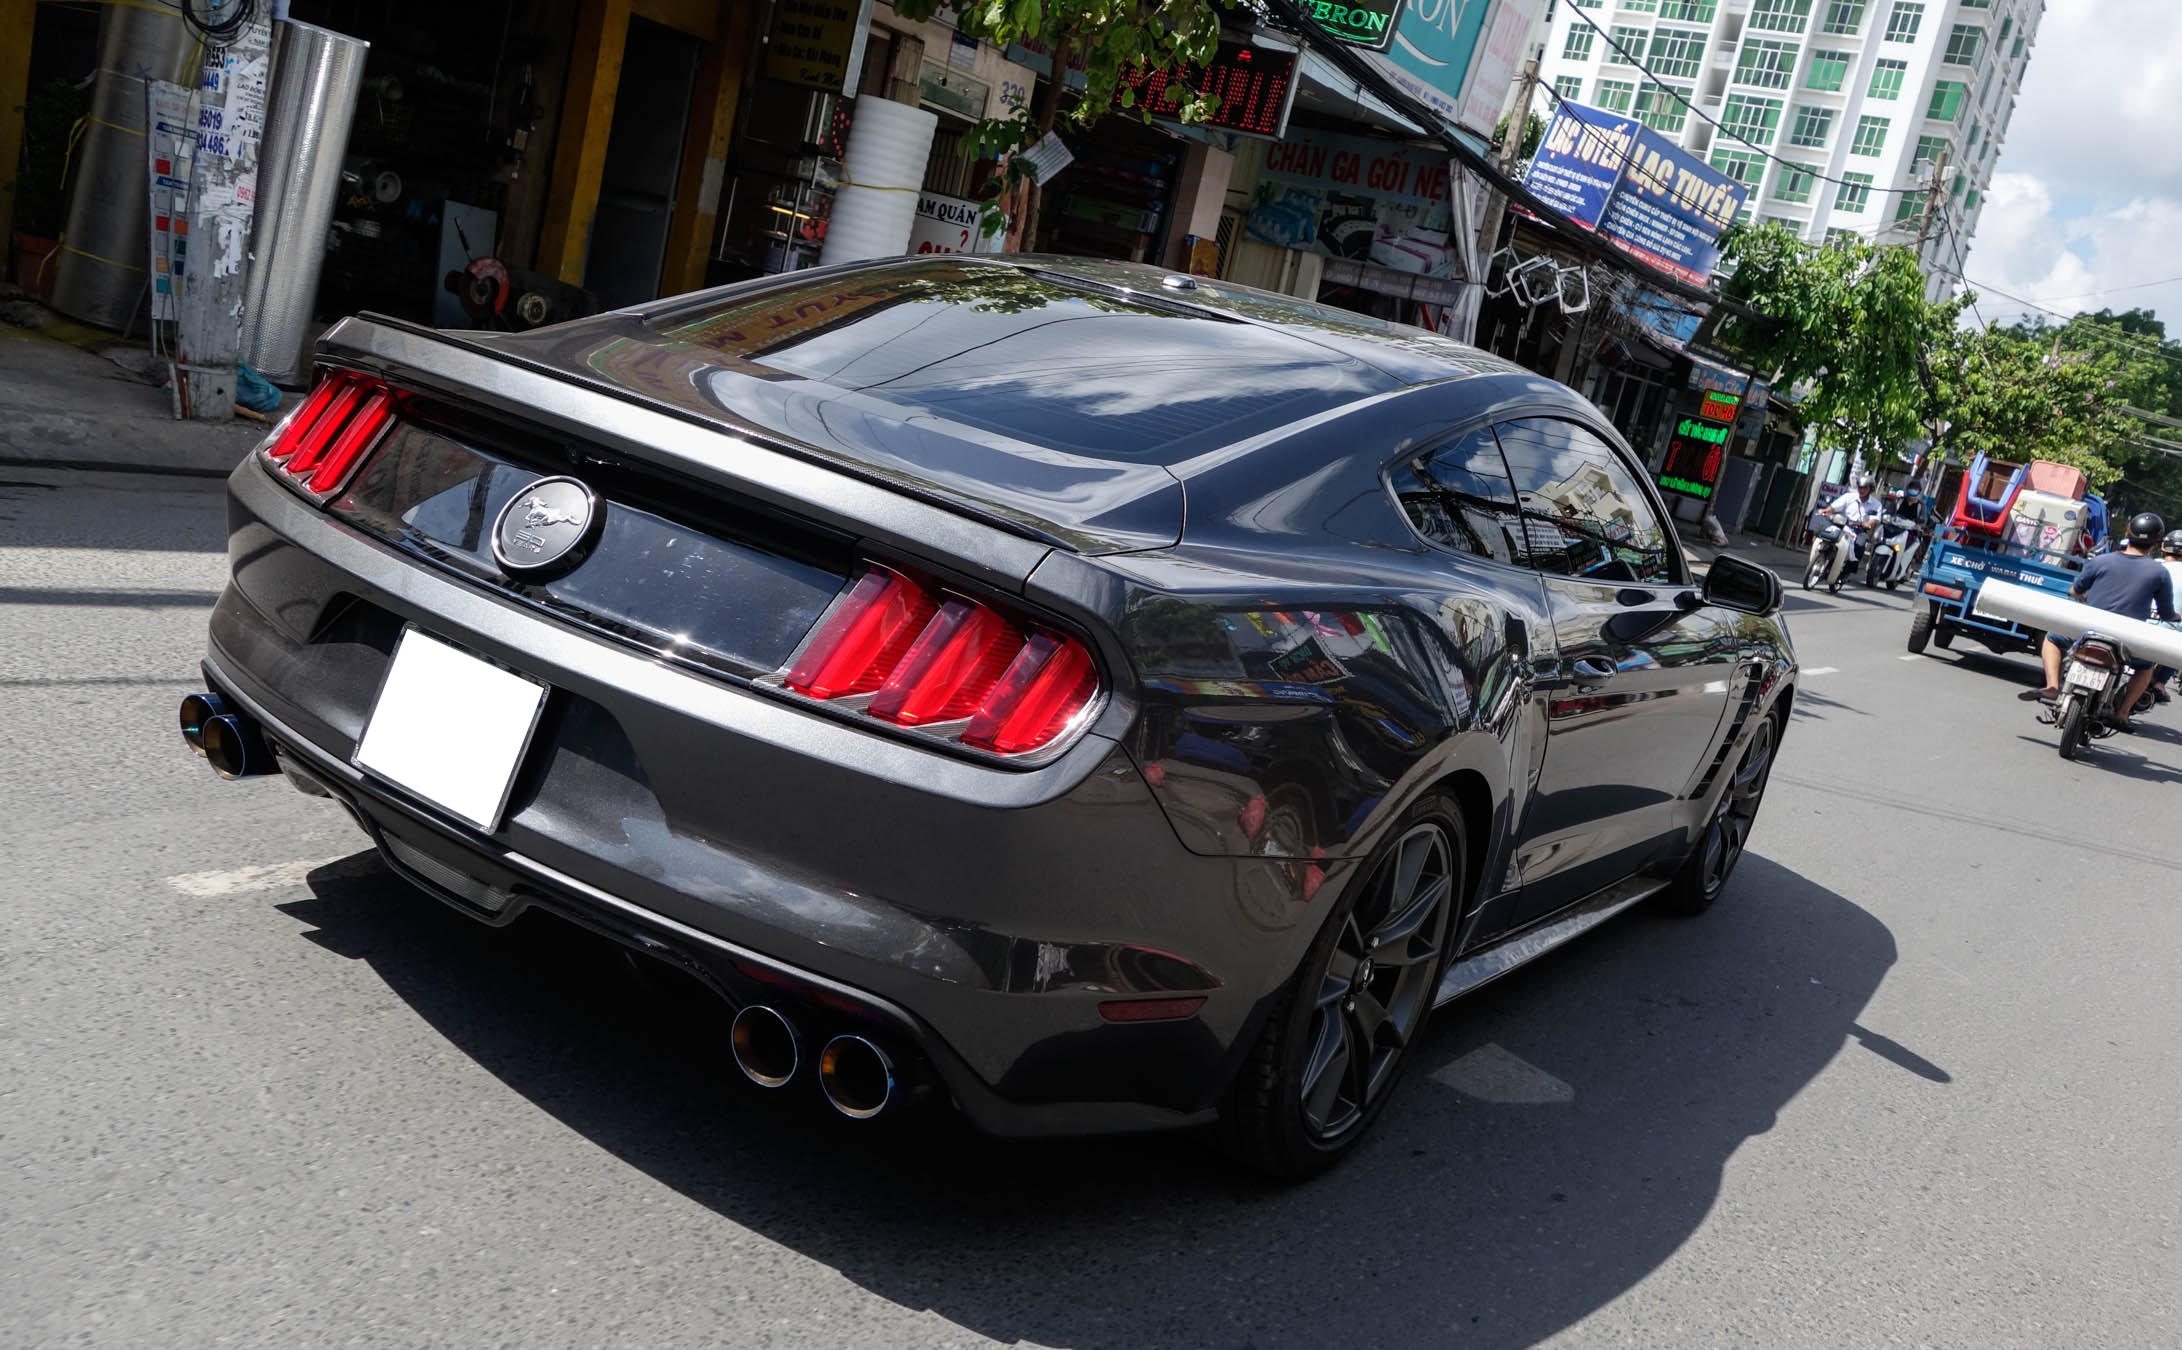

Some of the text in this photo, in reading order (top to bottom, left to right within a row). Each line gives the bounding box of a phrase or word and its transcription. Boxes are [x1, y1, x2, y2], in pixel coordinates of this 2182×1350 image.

[1308, 1, 1389, 32] ERON
[1266, 136, 1327, 178] CHĂN
[1331, 150, 1361, 185] GA
[1367, 150, 1409, 194] GỐI
[937, 203, 977, 225] QUÁN
[1949, 555, 1964, 567] XE
